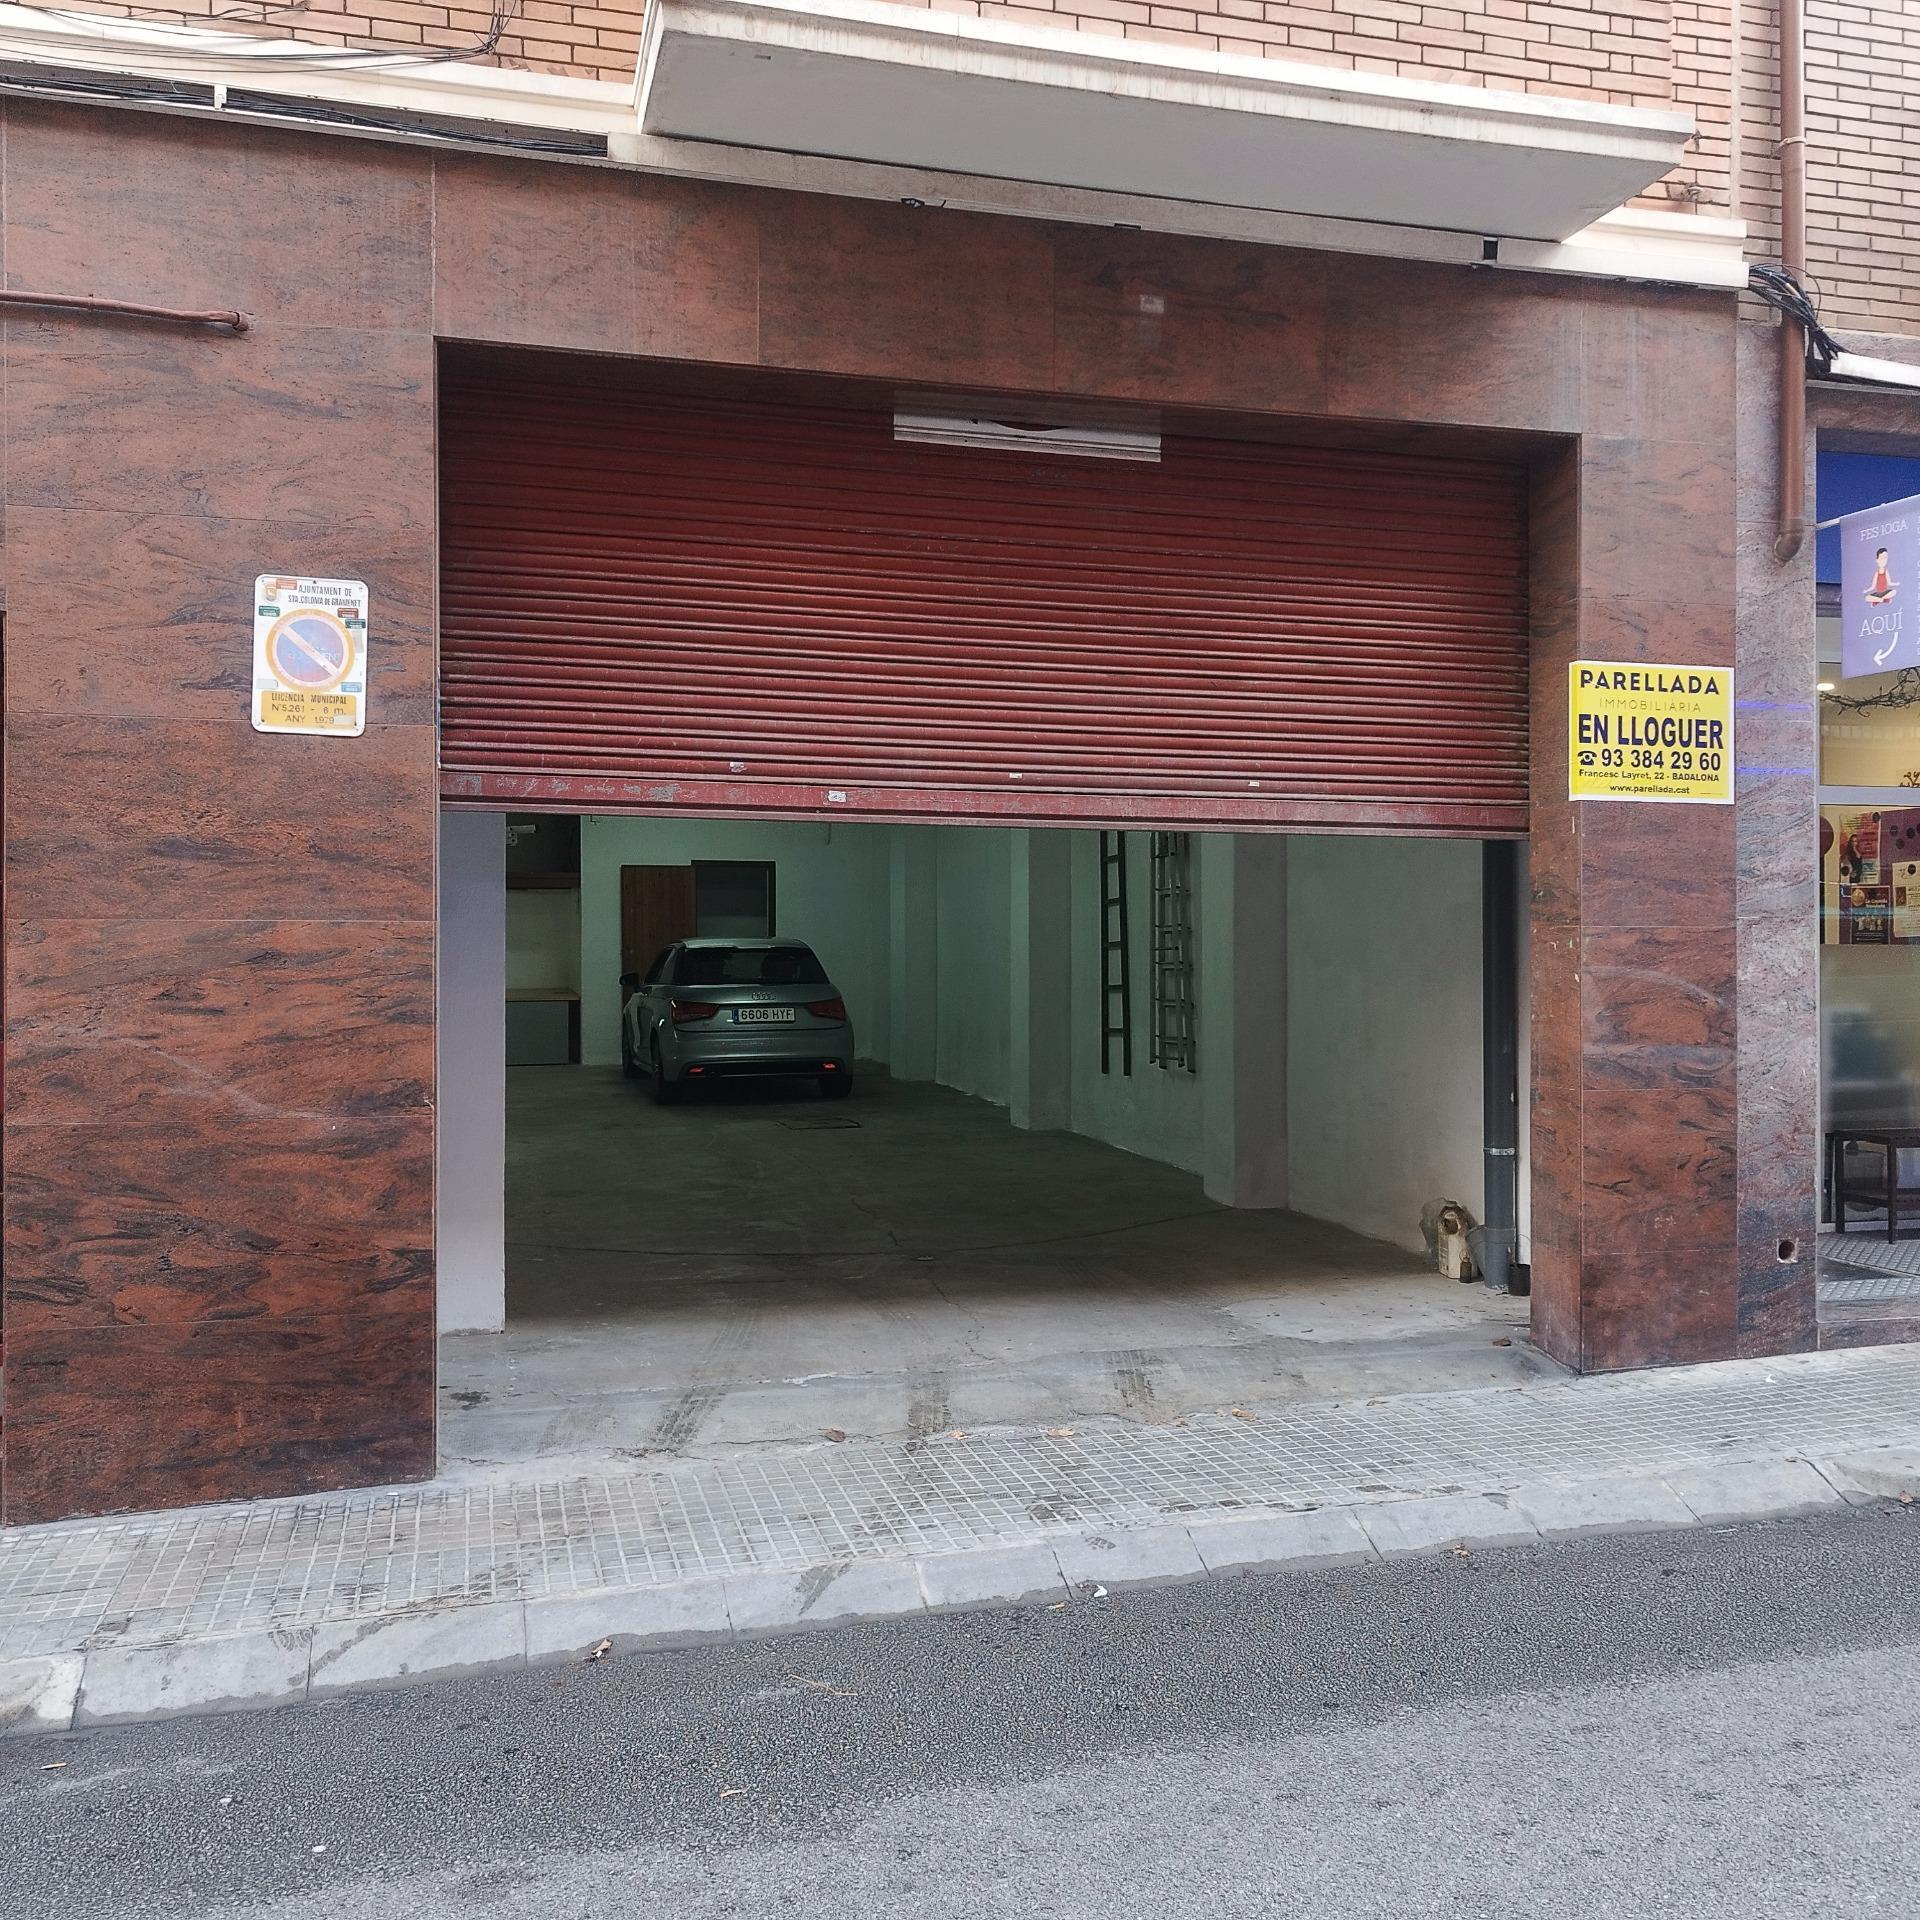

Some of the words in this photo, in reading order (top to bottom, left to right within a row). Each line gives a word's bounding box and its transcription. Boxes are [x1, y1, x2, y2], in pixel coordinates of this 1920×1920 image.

[1860, 527, 1879, 541] FES
[1880, 520, 1908, 536] IOGA
[298, 585, 341, 595] AJUNTAMENT
[345, 588, 352, 596] DE
[1858, 608, 1904, 637] AQUÍ
[1580, 670, 1719, 695] PARELLADA
[311, 695, 346, 704] MUNICIPAL
[1578, 714, 1608, 744] EN
[1618, 716, 1724, 749] LLOGUER
[1601, 749, 1623, 767] 93
[1631, 750, 1664, 768] 384
[1671, 752, 1692, 770] 29
[1699, 753, 1720, 771] 60
[1579, 769, 1619, 778] Francesc
[1622, 771, 1651, 780] Layret,
[1654, 772, 1665, 780] 22
[1672, 773, 1719, 782] BADALONA
[741, 1010, 769, 1019] 6606
[772, 1010, 792, 1019] HYF
